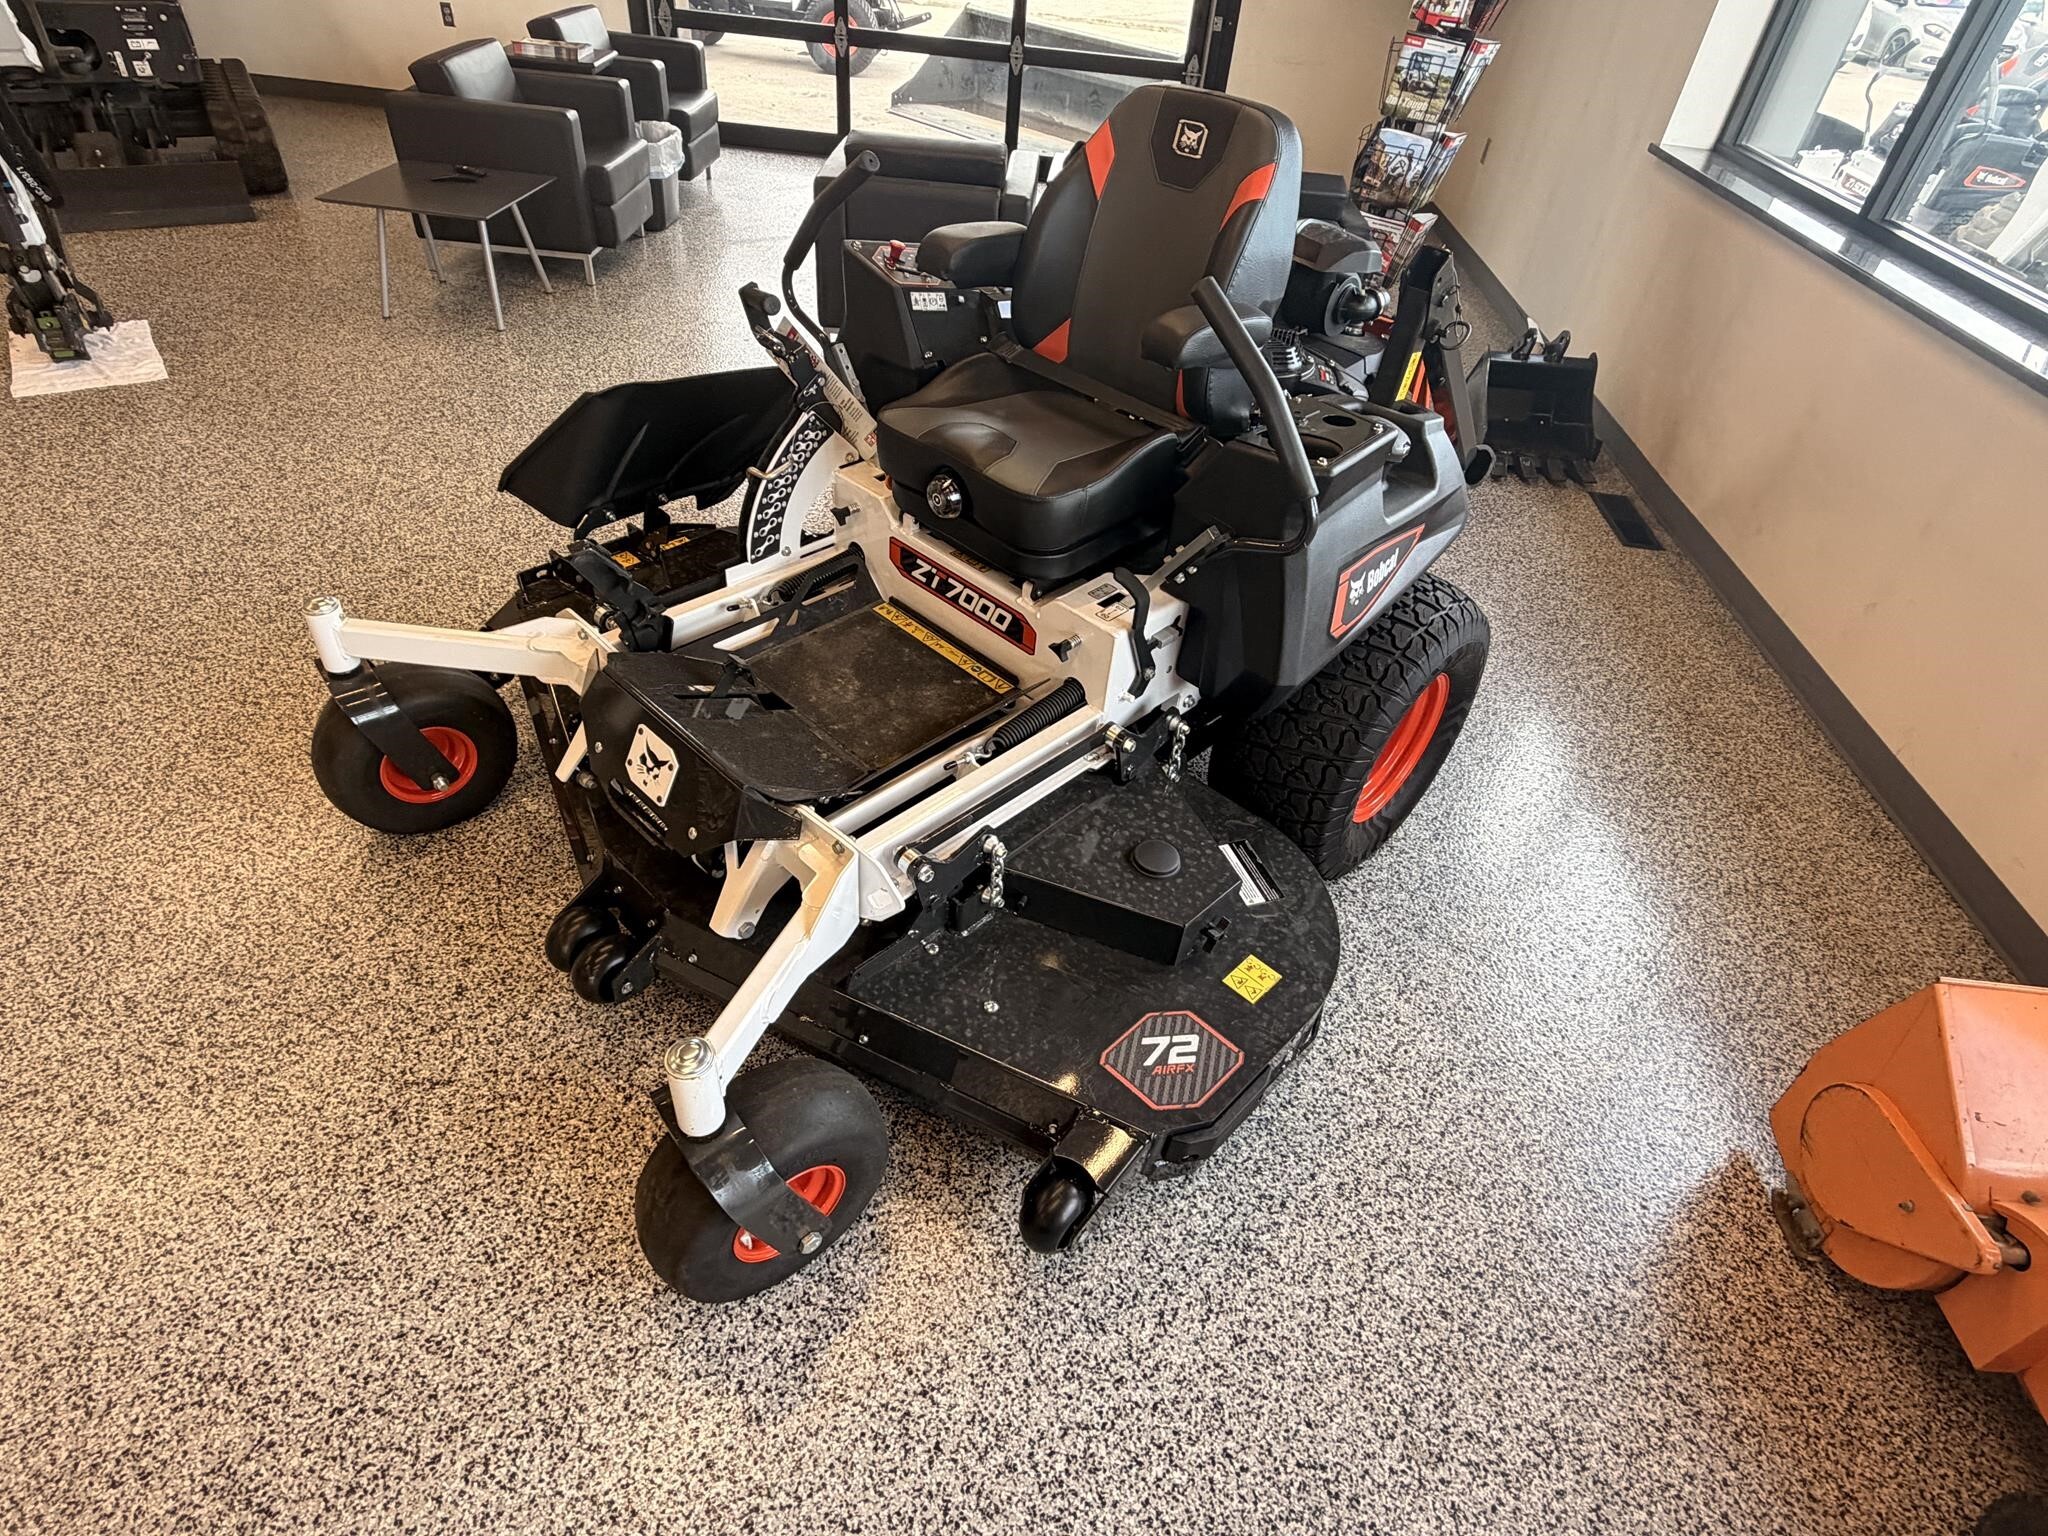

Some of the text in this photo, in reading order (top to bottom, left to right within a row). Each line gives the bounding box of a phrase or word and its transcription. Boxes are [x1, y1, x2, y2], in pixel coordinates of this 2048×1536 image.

[1366, 547, 1399, 594] Bobcat
[910, 558, 948, 590] ZT
[945, 577, 1013, 632] 7000
[1141, 1034, 1200, 1067] 72
[1152, 1063, 1196, 1076] AIRFX
